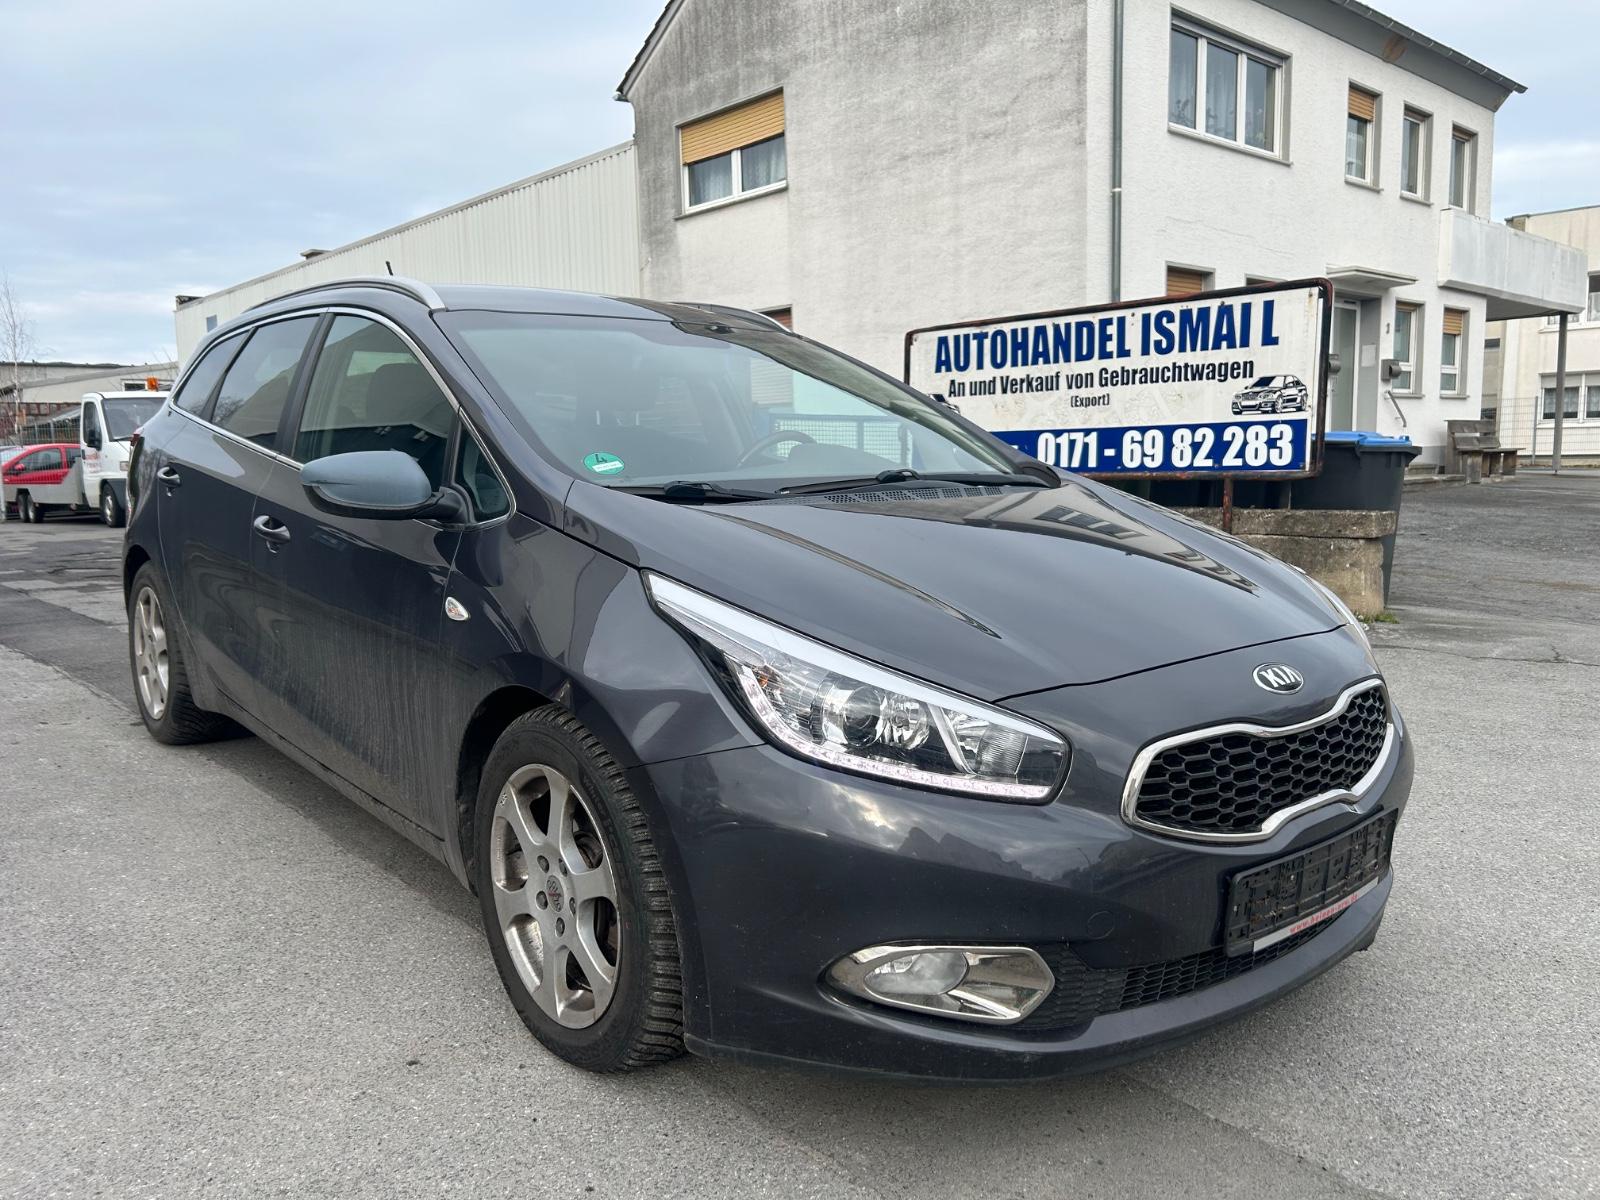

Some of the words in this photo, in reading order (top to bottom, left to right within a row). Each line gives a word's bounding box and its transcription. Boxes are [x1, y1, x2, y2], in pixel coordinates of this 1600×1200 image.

[934, 316, 1131, 374] AUTOHANDEL
[948, 379, 966, 398] An
[969, 376, 997, 396] und
[1000, 371, 1061, 395] Verkauf
[1065, 372, 1094, 390] von
[1098, 360, 1254, 387] Gebrauchtwagen
[595, 454, 607, 463] 4
[1037, 431, 1099, 468] 0171
[1122, 429, 1164, 469] 69
[1171, 427, 1215, 468] 82
[1222, 423, 1293, 468] 283
[1258, 665, 1302, 688] KIA
